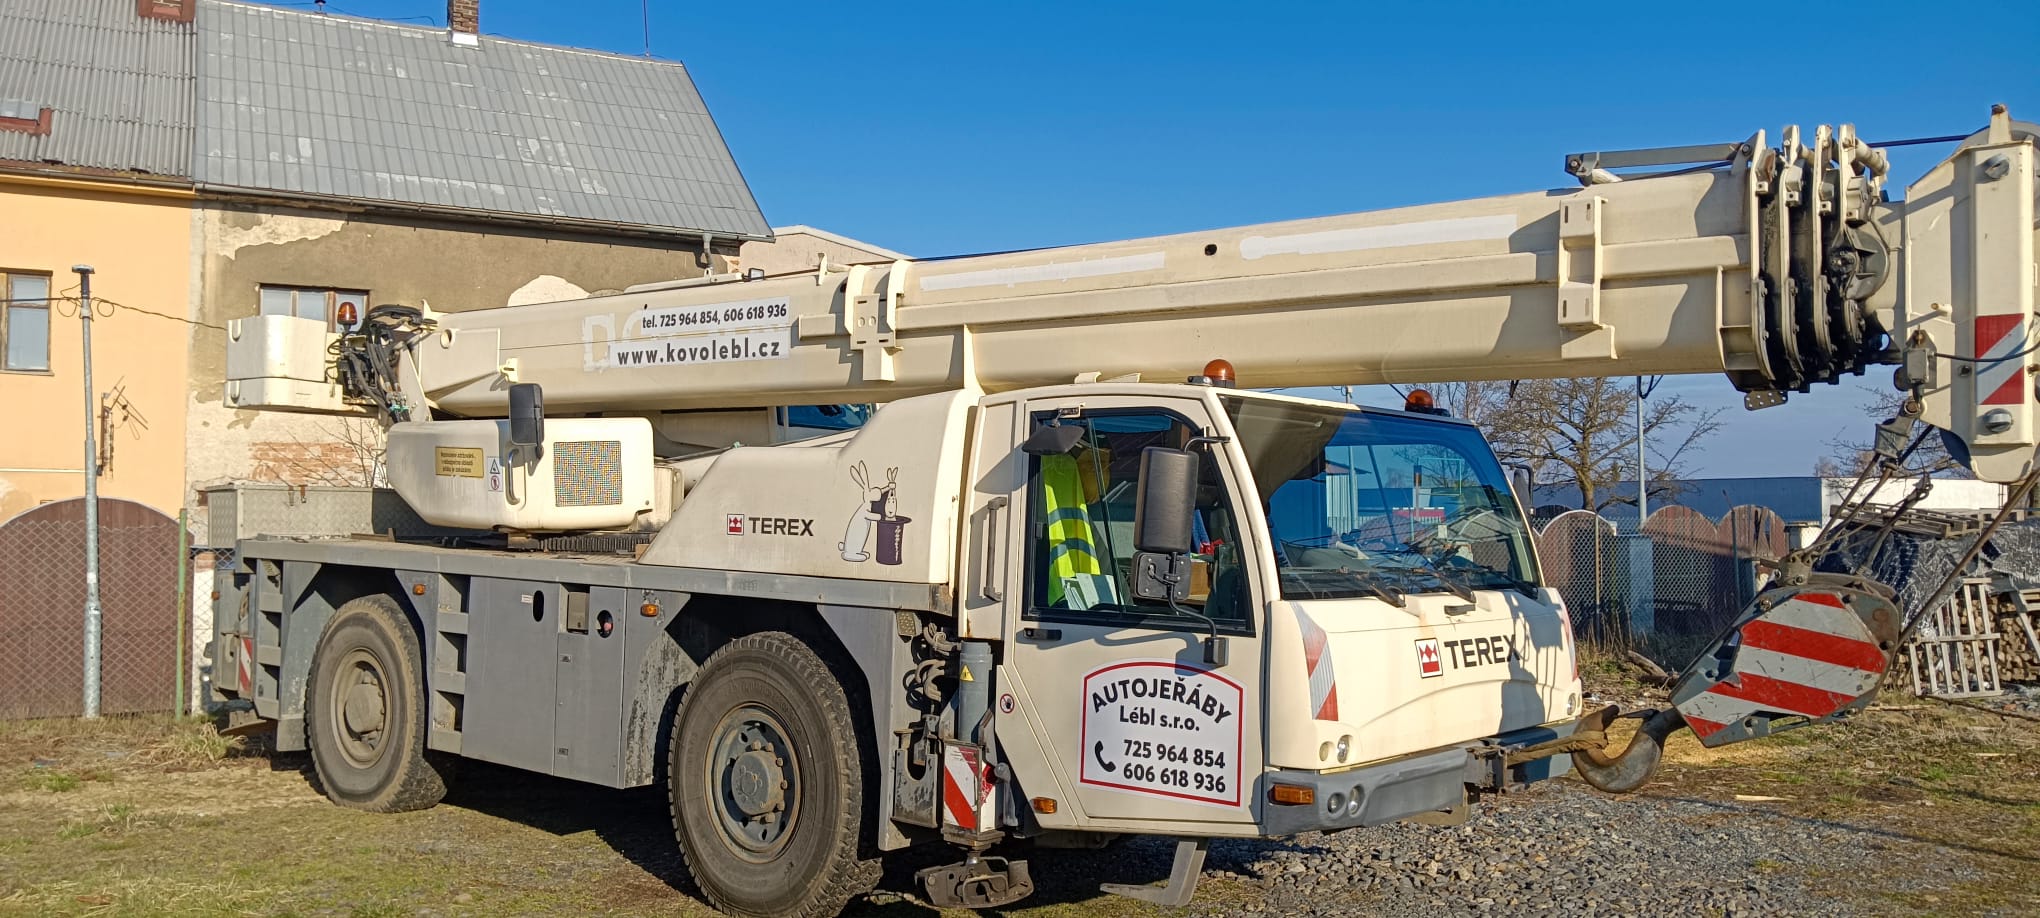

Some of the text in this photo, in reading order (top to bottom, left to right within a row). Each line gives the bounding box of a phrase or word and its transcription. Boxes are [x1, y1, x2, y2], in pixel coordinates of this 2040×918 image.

[642, 303, 787, 329] tel. 725 964 854, 606 618 936
[617, 336, 780, 365] www.kovolebl.cz
[749, 516, 815, 537] TEREX
[1444, 634, 1520, 669] TEREX
[1092, 677, 1232, 724] AUTOJEŘÁBY
[1119, 705, 1200, 732] Lébl s.r.o.
[1123, 739, 1226, 769] 725 964 854
[1123, 763, 1226, 793] 606 618 936
